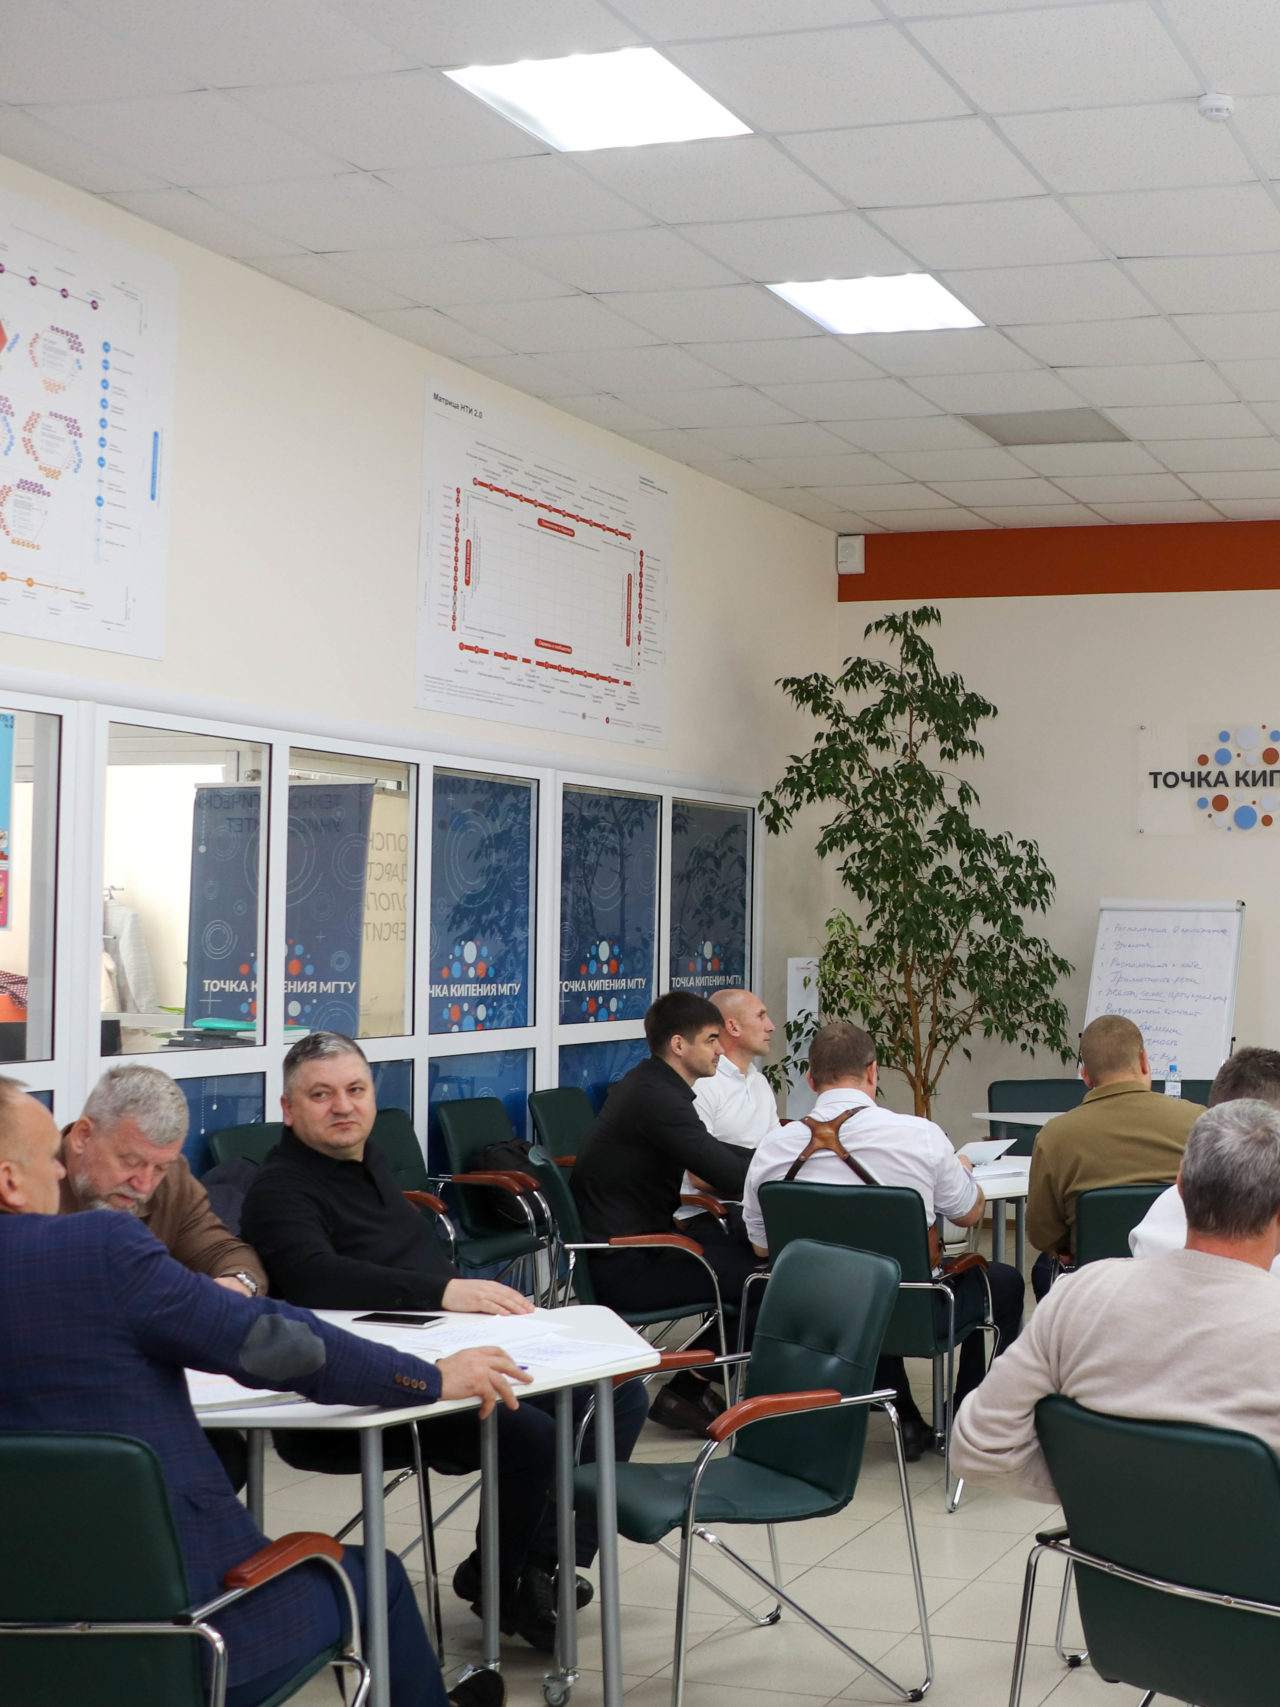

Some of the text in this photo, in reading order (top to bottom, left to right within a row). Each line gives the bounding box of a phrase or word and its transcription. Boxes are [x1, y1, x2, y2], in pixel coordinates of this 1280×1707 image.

[433, 392, 483, 419] Матрица НТИ 2.0
[1149, 770, 1229, 789] ТОЧКА
[203, 980, 249, 992] ТОЧКА
[319, 981, 356, 993] МГТУ
[587, 979, 626, 991] КИПЕНИЯ
[627, 978, 647, 990] МГТУ
[671, 974, 743, 988] ТОЧКА КИПЕНИЯ МГТУ
[450, 984, 496, 997] КИПЕНИЯ
[498, 983, 520, 996] МГТУ
